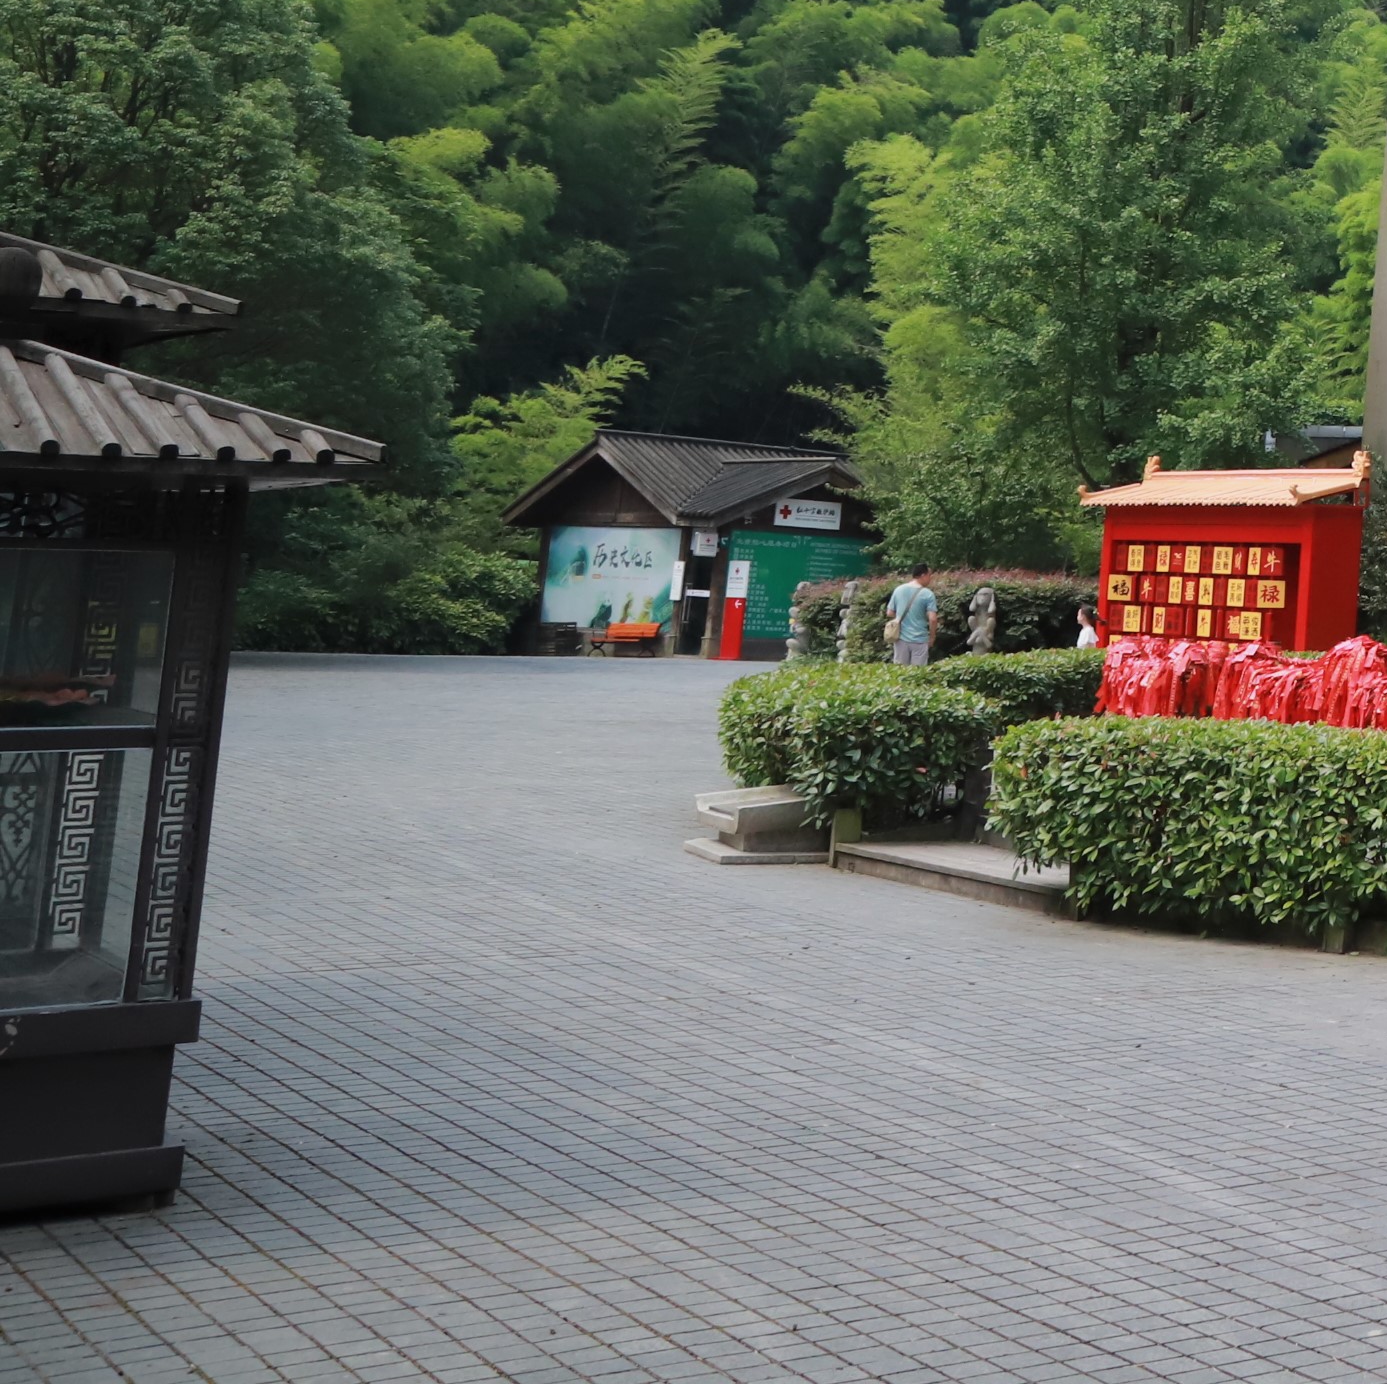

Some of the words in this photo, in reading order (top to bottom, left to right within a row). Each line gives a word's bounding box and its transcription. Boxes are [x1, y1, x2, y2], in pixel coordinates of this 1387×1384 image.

[1263, 550, 1281, 573] 牛
[1112, 580, 1130, 597] 福
[1184, 581, 1196, 601] 喜
[1260, 585, 1281, 604] 禄
